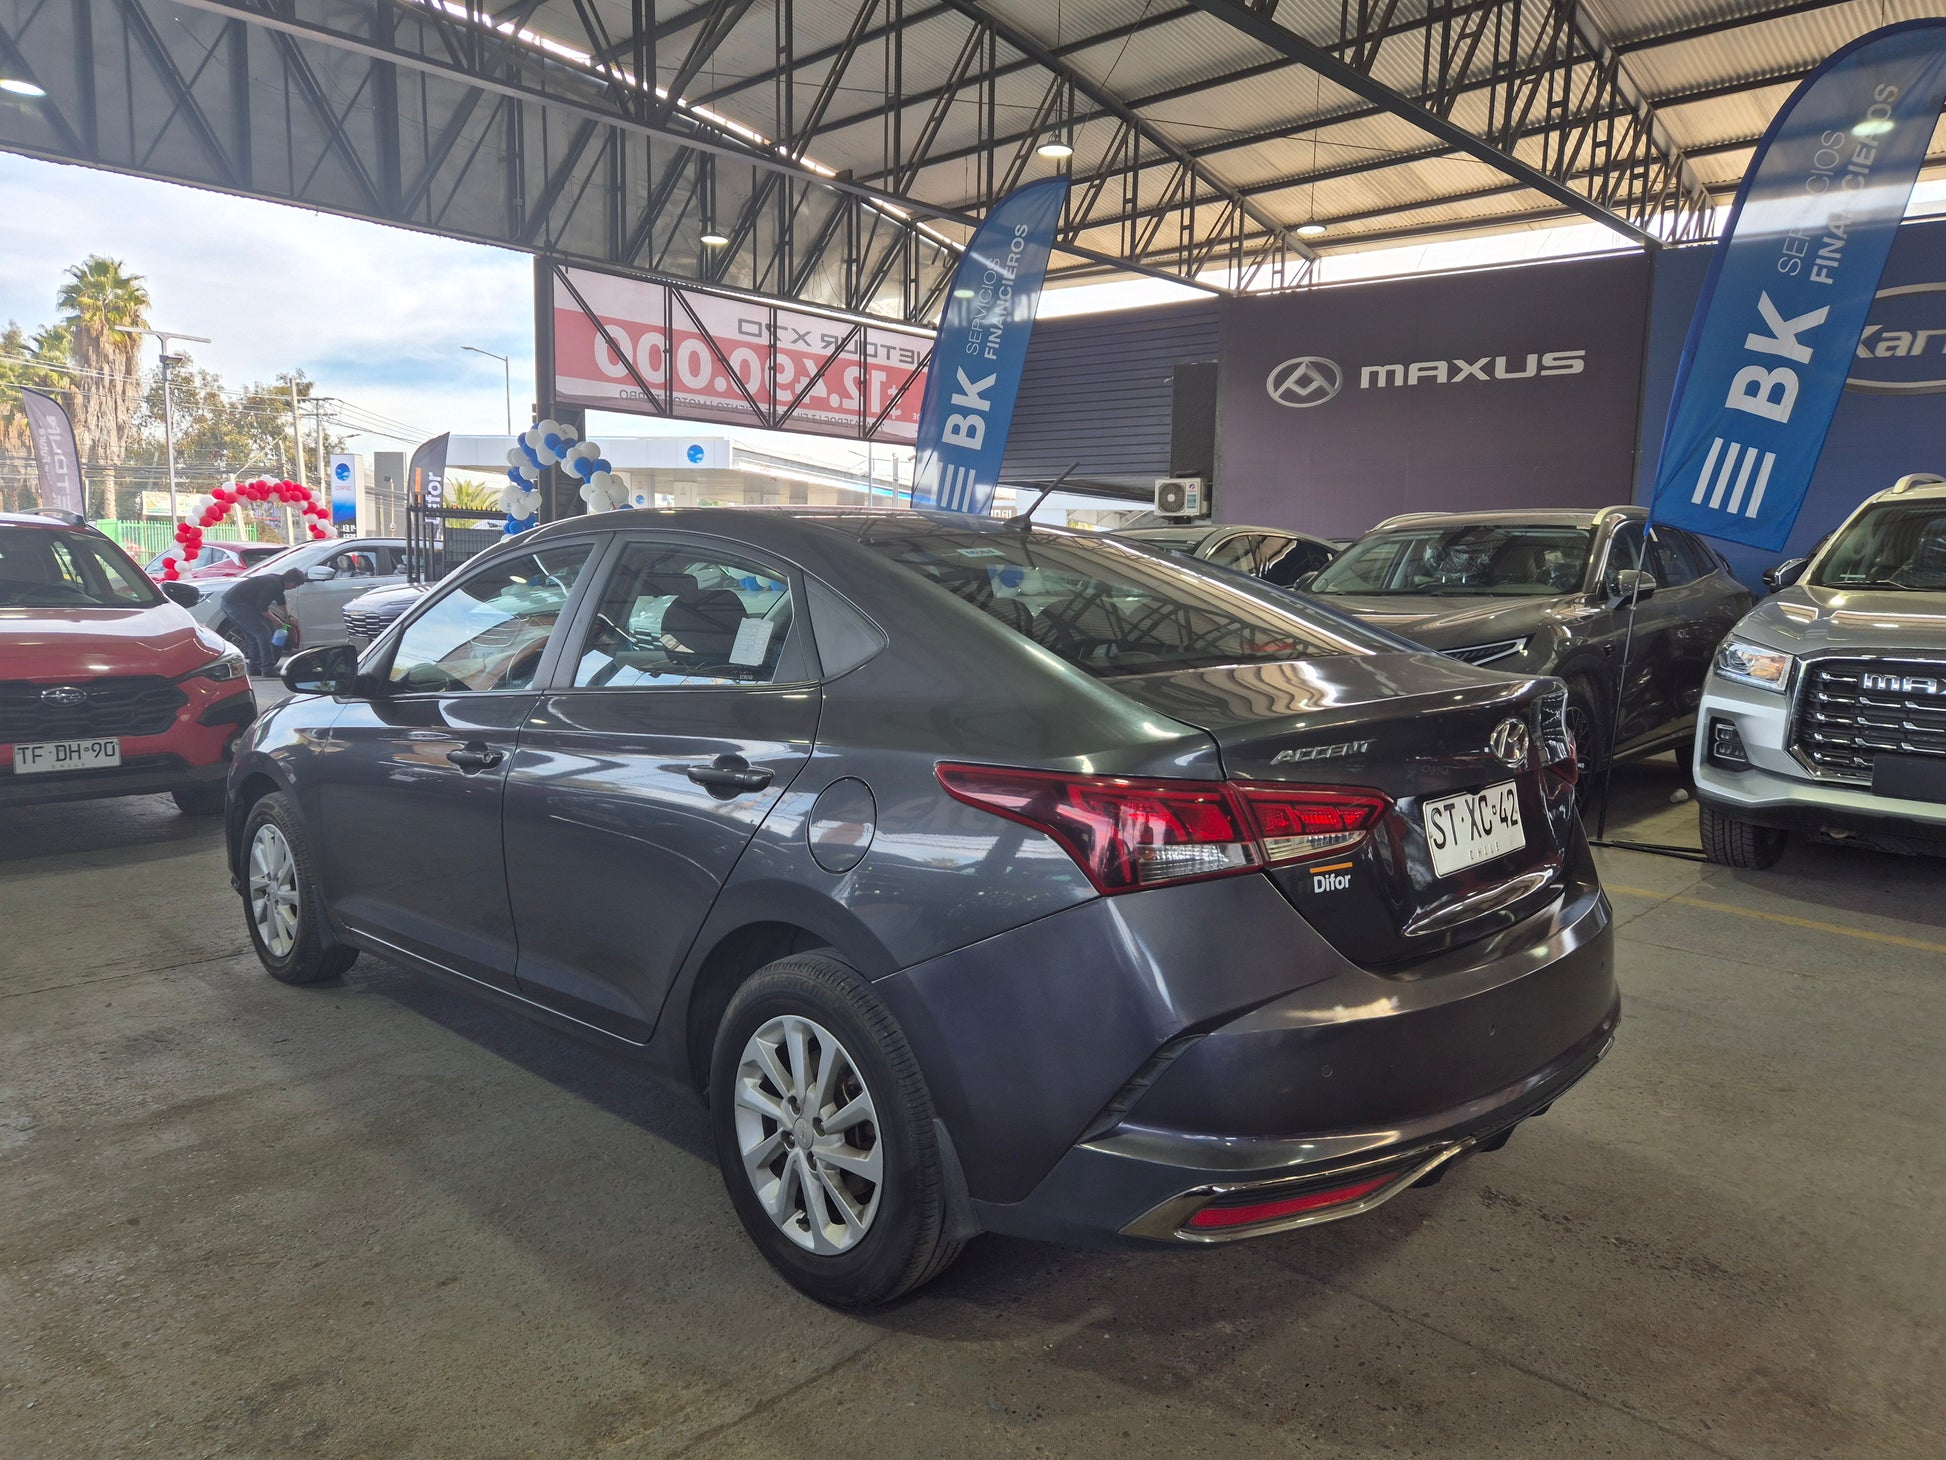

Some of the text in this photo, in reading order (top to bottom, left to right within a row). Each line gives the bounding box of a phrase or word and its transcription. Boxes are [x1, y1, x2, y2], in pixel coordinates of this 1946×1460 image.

[965, 256, 1001, 356] SERVICIOS
[983, 223, 1029, 361] FINANCIEROS
[1359, 349, 1586, 389] MAXUS
[1724, 289, 1831, 424] BK
[941, 365, 997, 451] BK
[1269, 739, 1377, 766] ACCENT
[1468, 841, 1501, 861] CHILE
[1313, 873, 1352, 894] Difor
